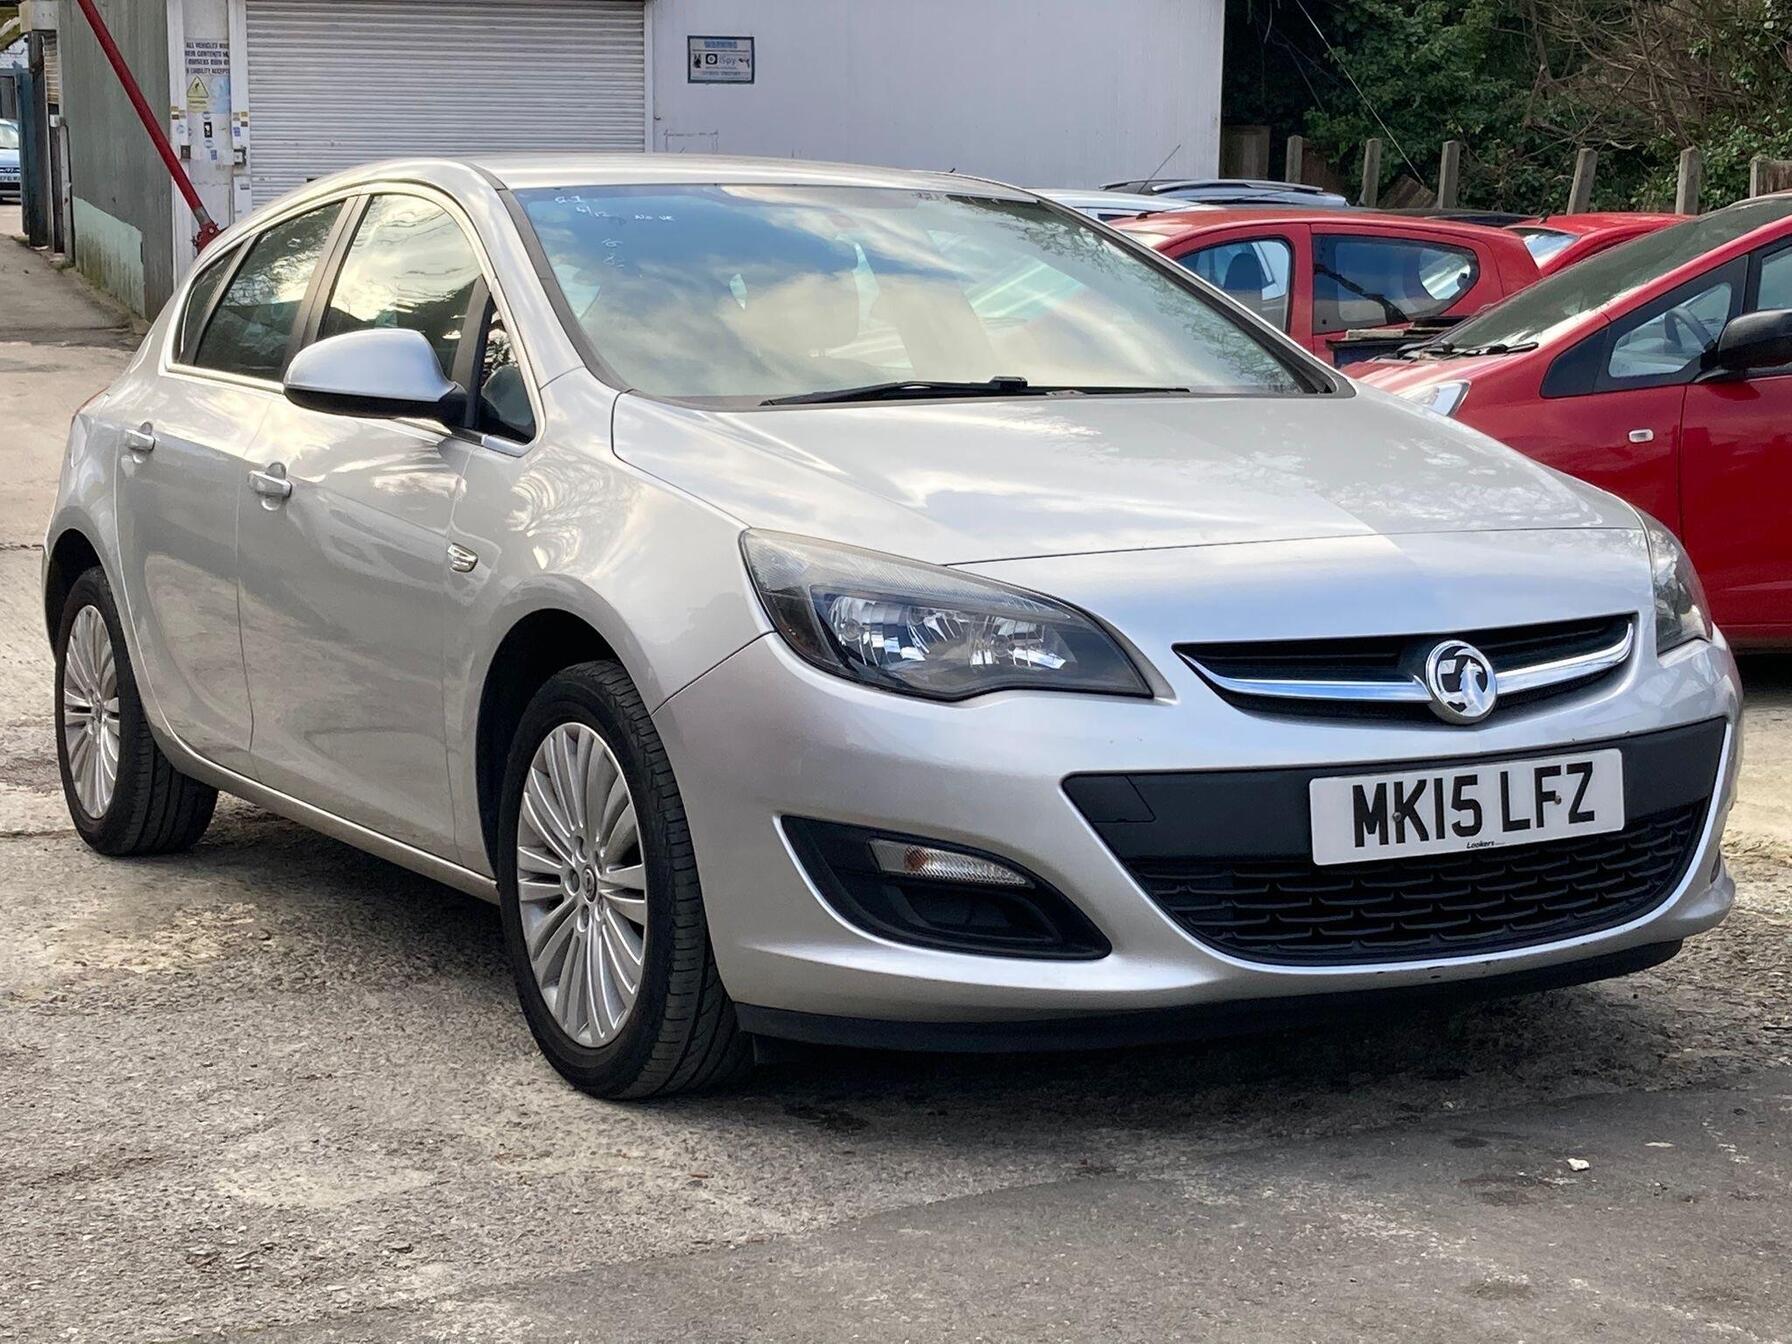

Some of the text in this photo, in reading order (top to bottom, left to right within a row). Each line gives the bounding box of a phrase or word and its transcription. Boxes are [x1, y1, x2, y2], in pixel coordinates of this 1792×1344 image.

[1352, 761, 1595, 848] MK15 LFZ
[1466, 840, 1495, 849] Lookers
